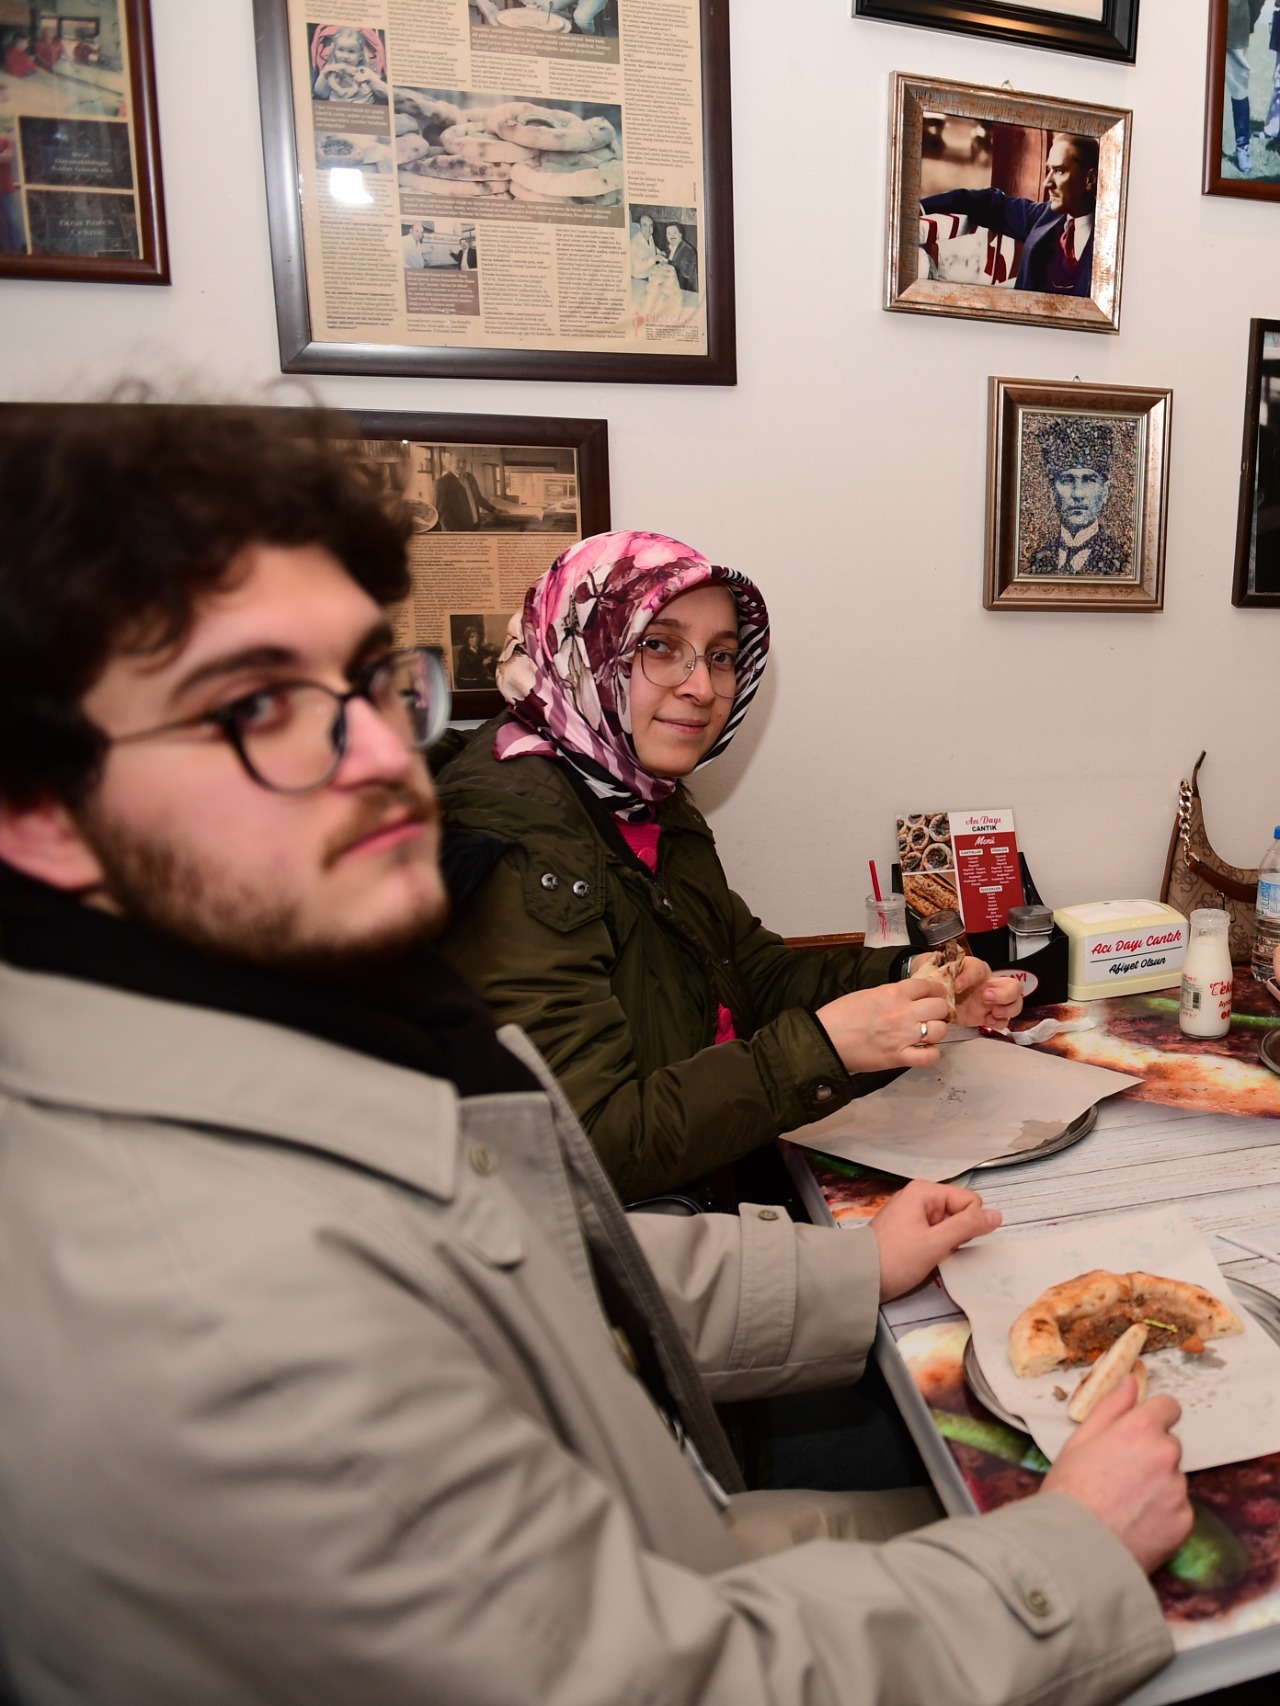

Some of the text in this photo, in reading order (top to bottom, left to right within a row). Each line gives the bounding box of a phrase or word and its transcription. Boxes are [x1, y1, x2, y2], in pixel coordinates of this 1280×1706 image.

[1091, 930, 1182, 955] Acı Dayı Cantık
[1109, 956, 1166, 974] Afiyet Olsun
